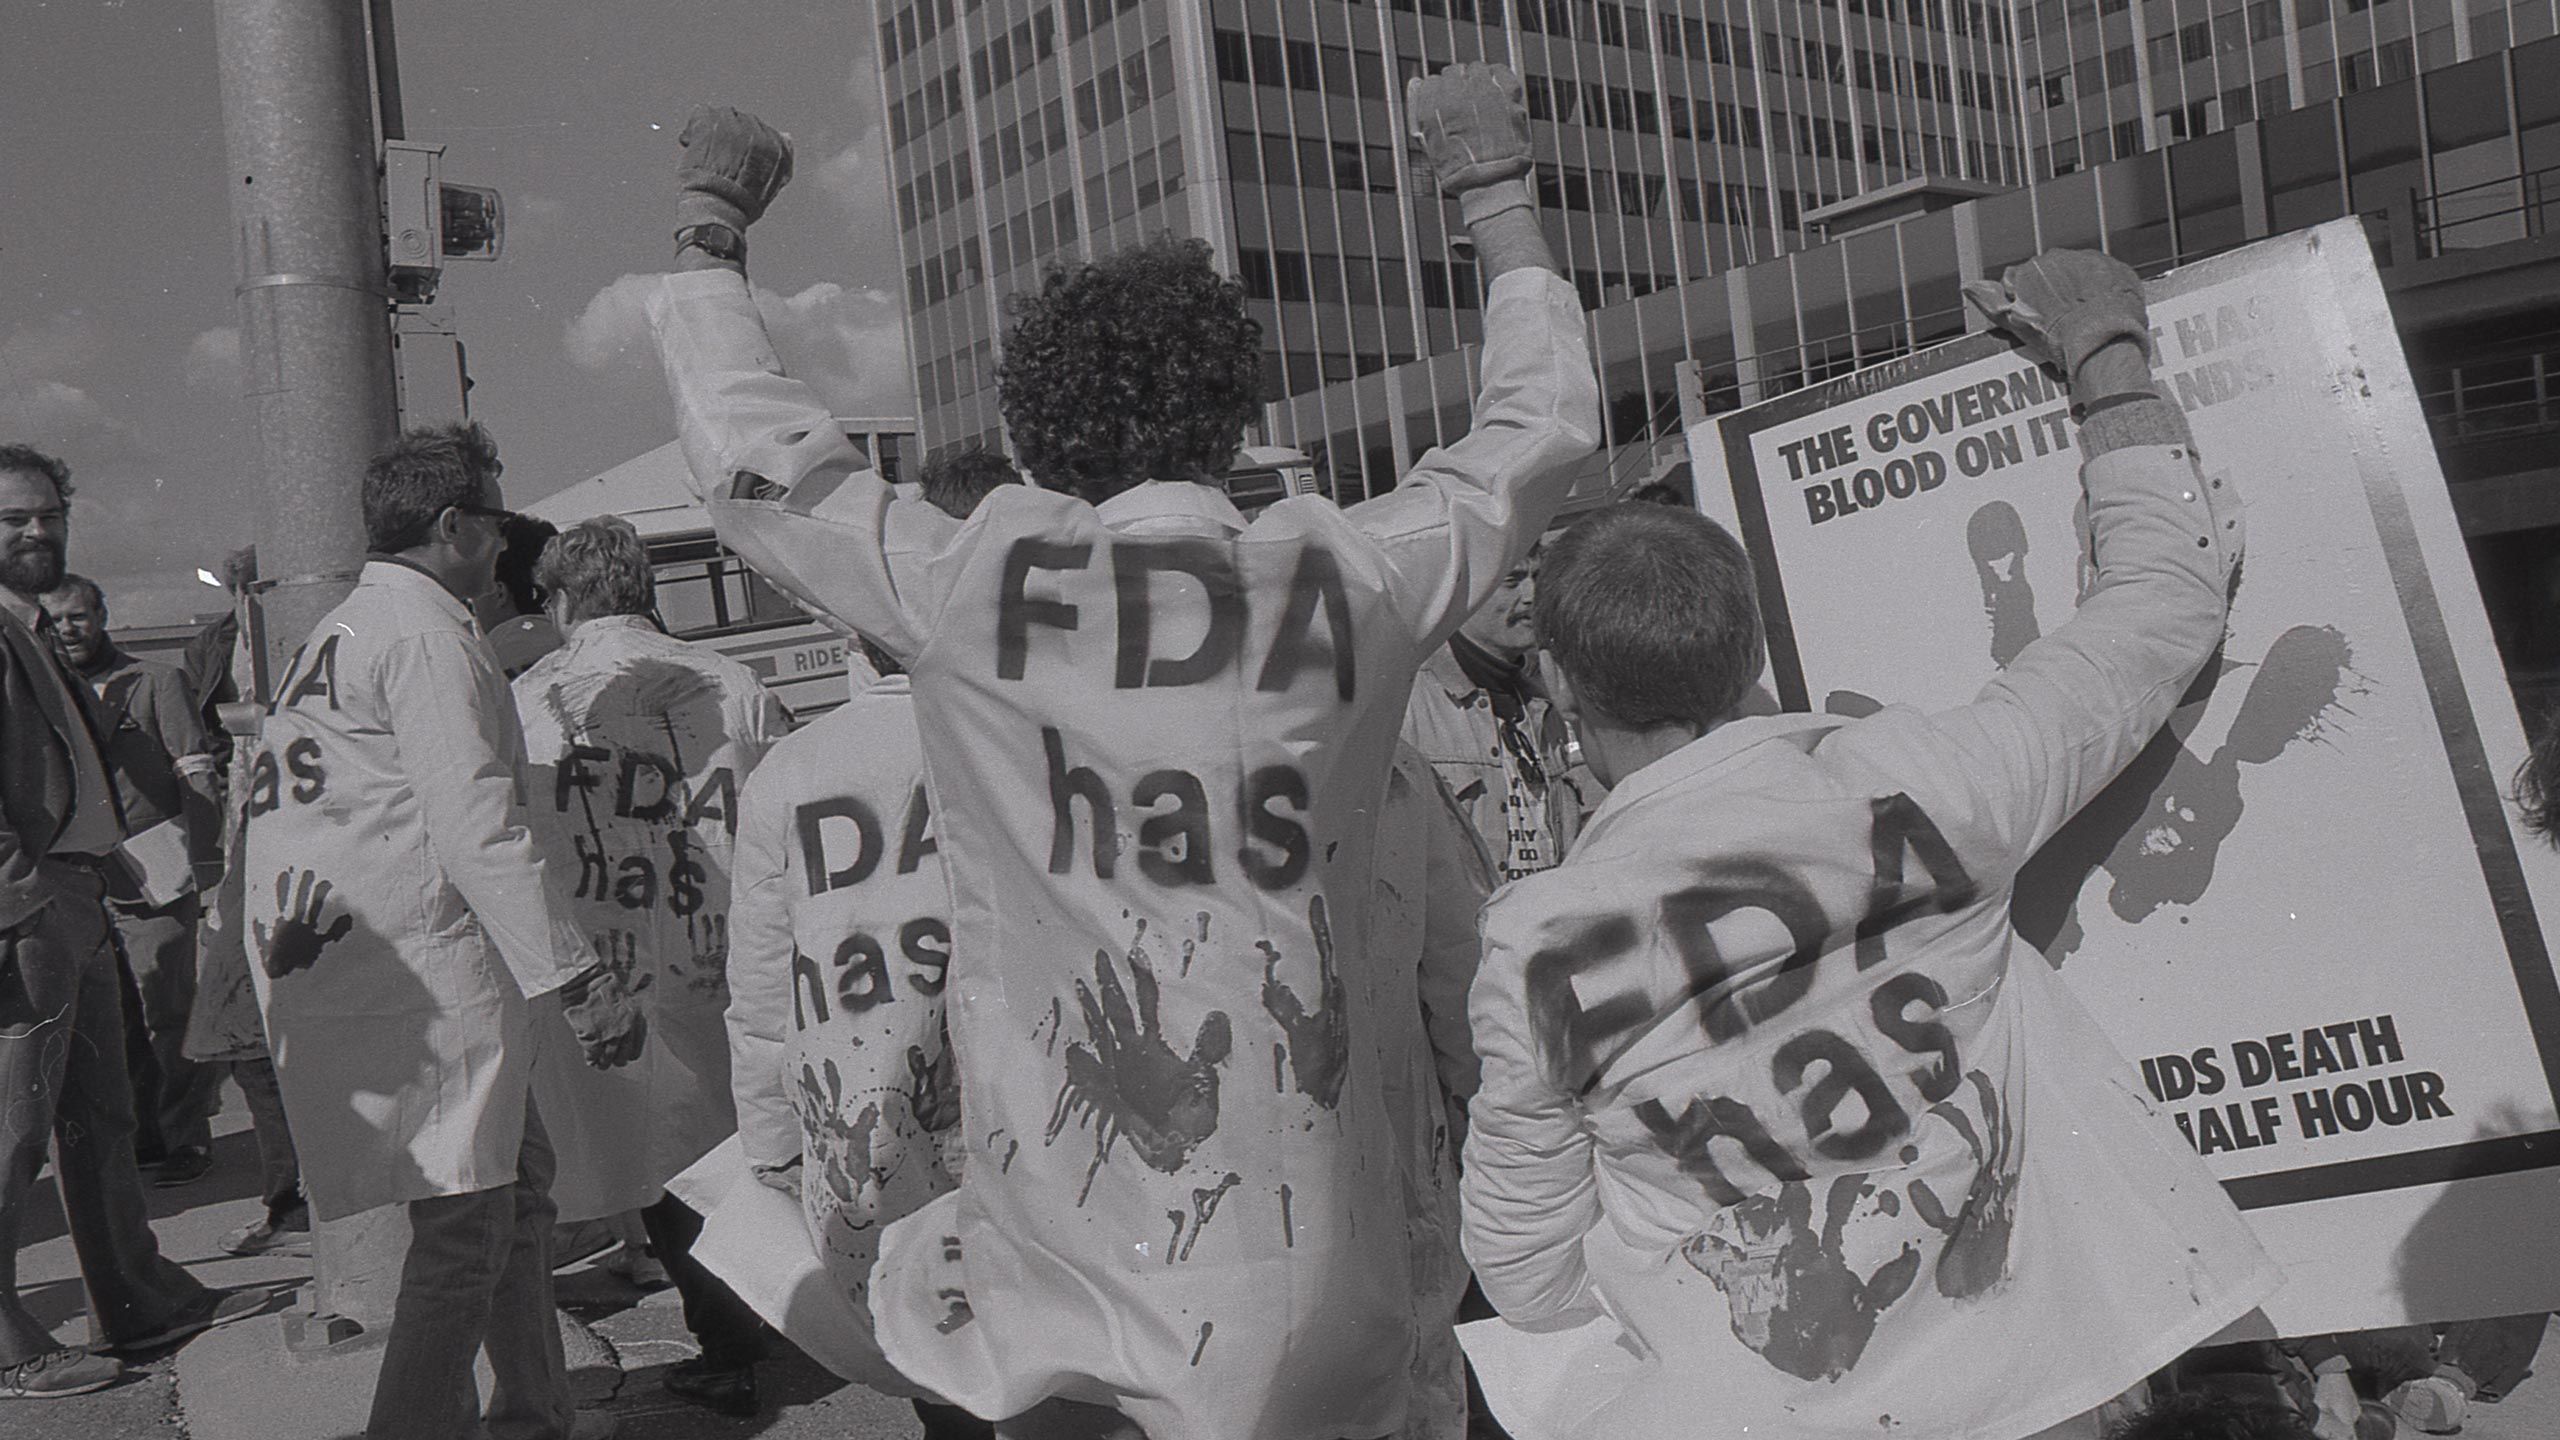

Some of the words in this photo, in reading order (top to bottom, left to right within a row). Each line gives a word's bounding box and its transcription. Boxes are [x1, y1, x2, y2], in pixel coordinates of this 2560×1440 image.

[1778, 425, 1859, 481] THE
[1804, 451, 1947, 525] BLOOD
[1955, 425, 2023, 478] ON
[2027, 407, 2072, 458] IT
[2153, 347, 2276, 413] NDS
[997, 537, 1356, 702] FDA
[250, 737, 326, 818] as
[556, 745, 738, 836] FDA
[1041, 726, 1311, 891] has
[574, 834, 706, 916] has
[796, 784, 939, 897] DA
[792, 916, 952, 1032] has
[1524, 791, 1980, 1096] FDA
[1635, 972, 1961, 1207] has
[2140, 1047, 2226, 1102] IDS
[2231, 1014, 2404, 1088] DEATH
[2292, 1071, 2455, 1140] HOUR
